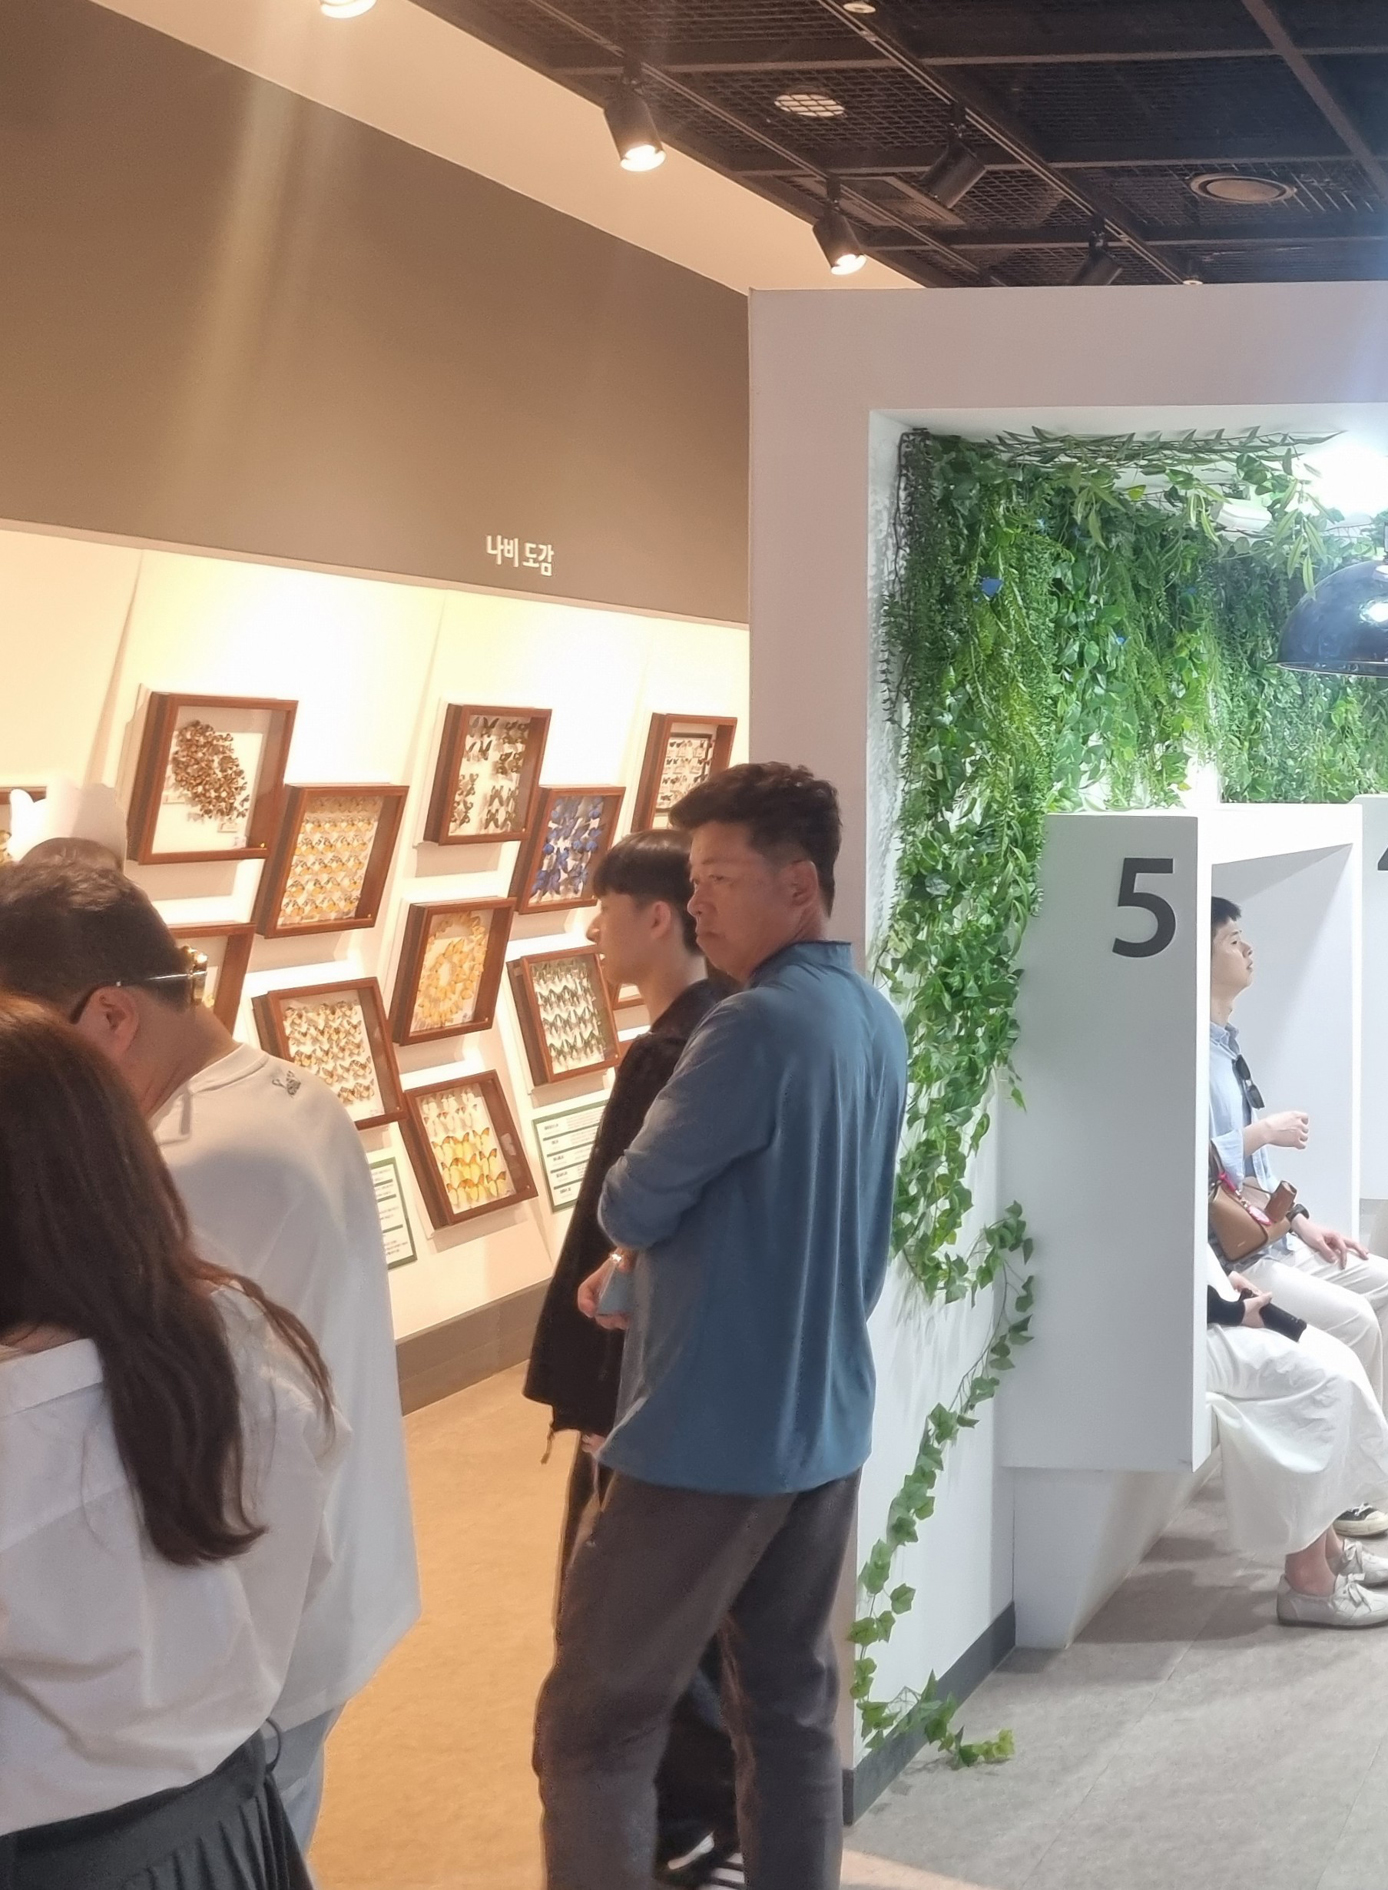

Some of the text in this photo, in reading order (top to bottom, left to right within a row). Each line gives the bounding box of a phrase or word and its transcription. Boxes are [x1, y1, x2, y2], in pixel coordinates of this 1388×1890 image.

[486, 534, 555, 577] 나비 도감
[1111, 857, 1177, 959] 5
